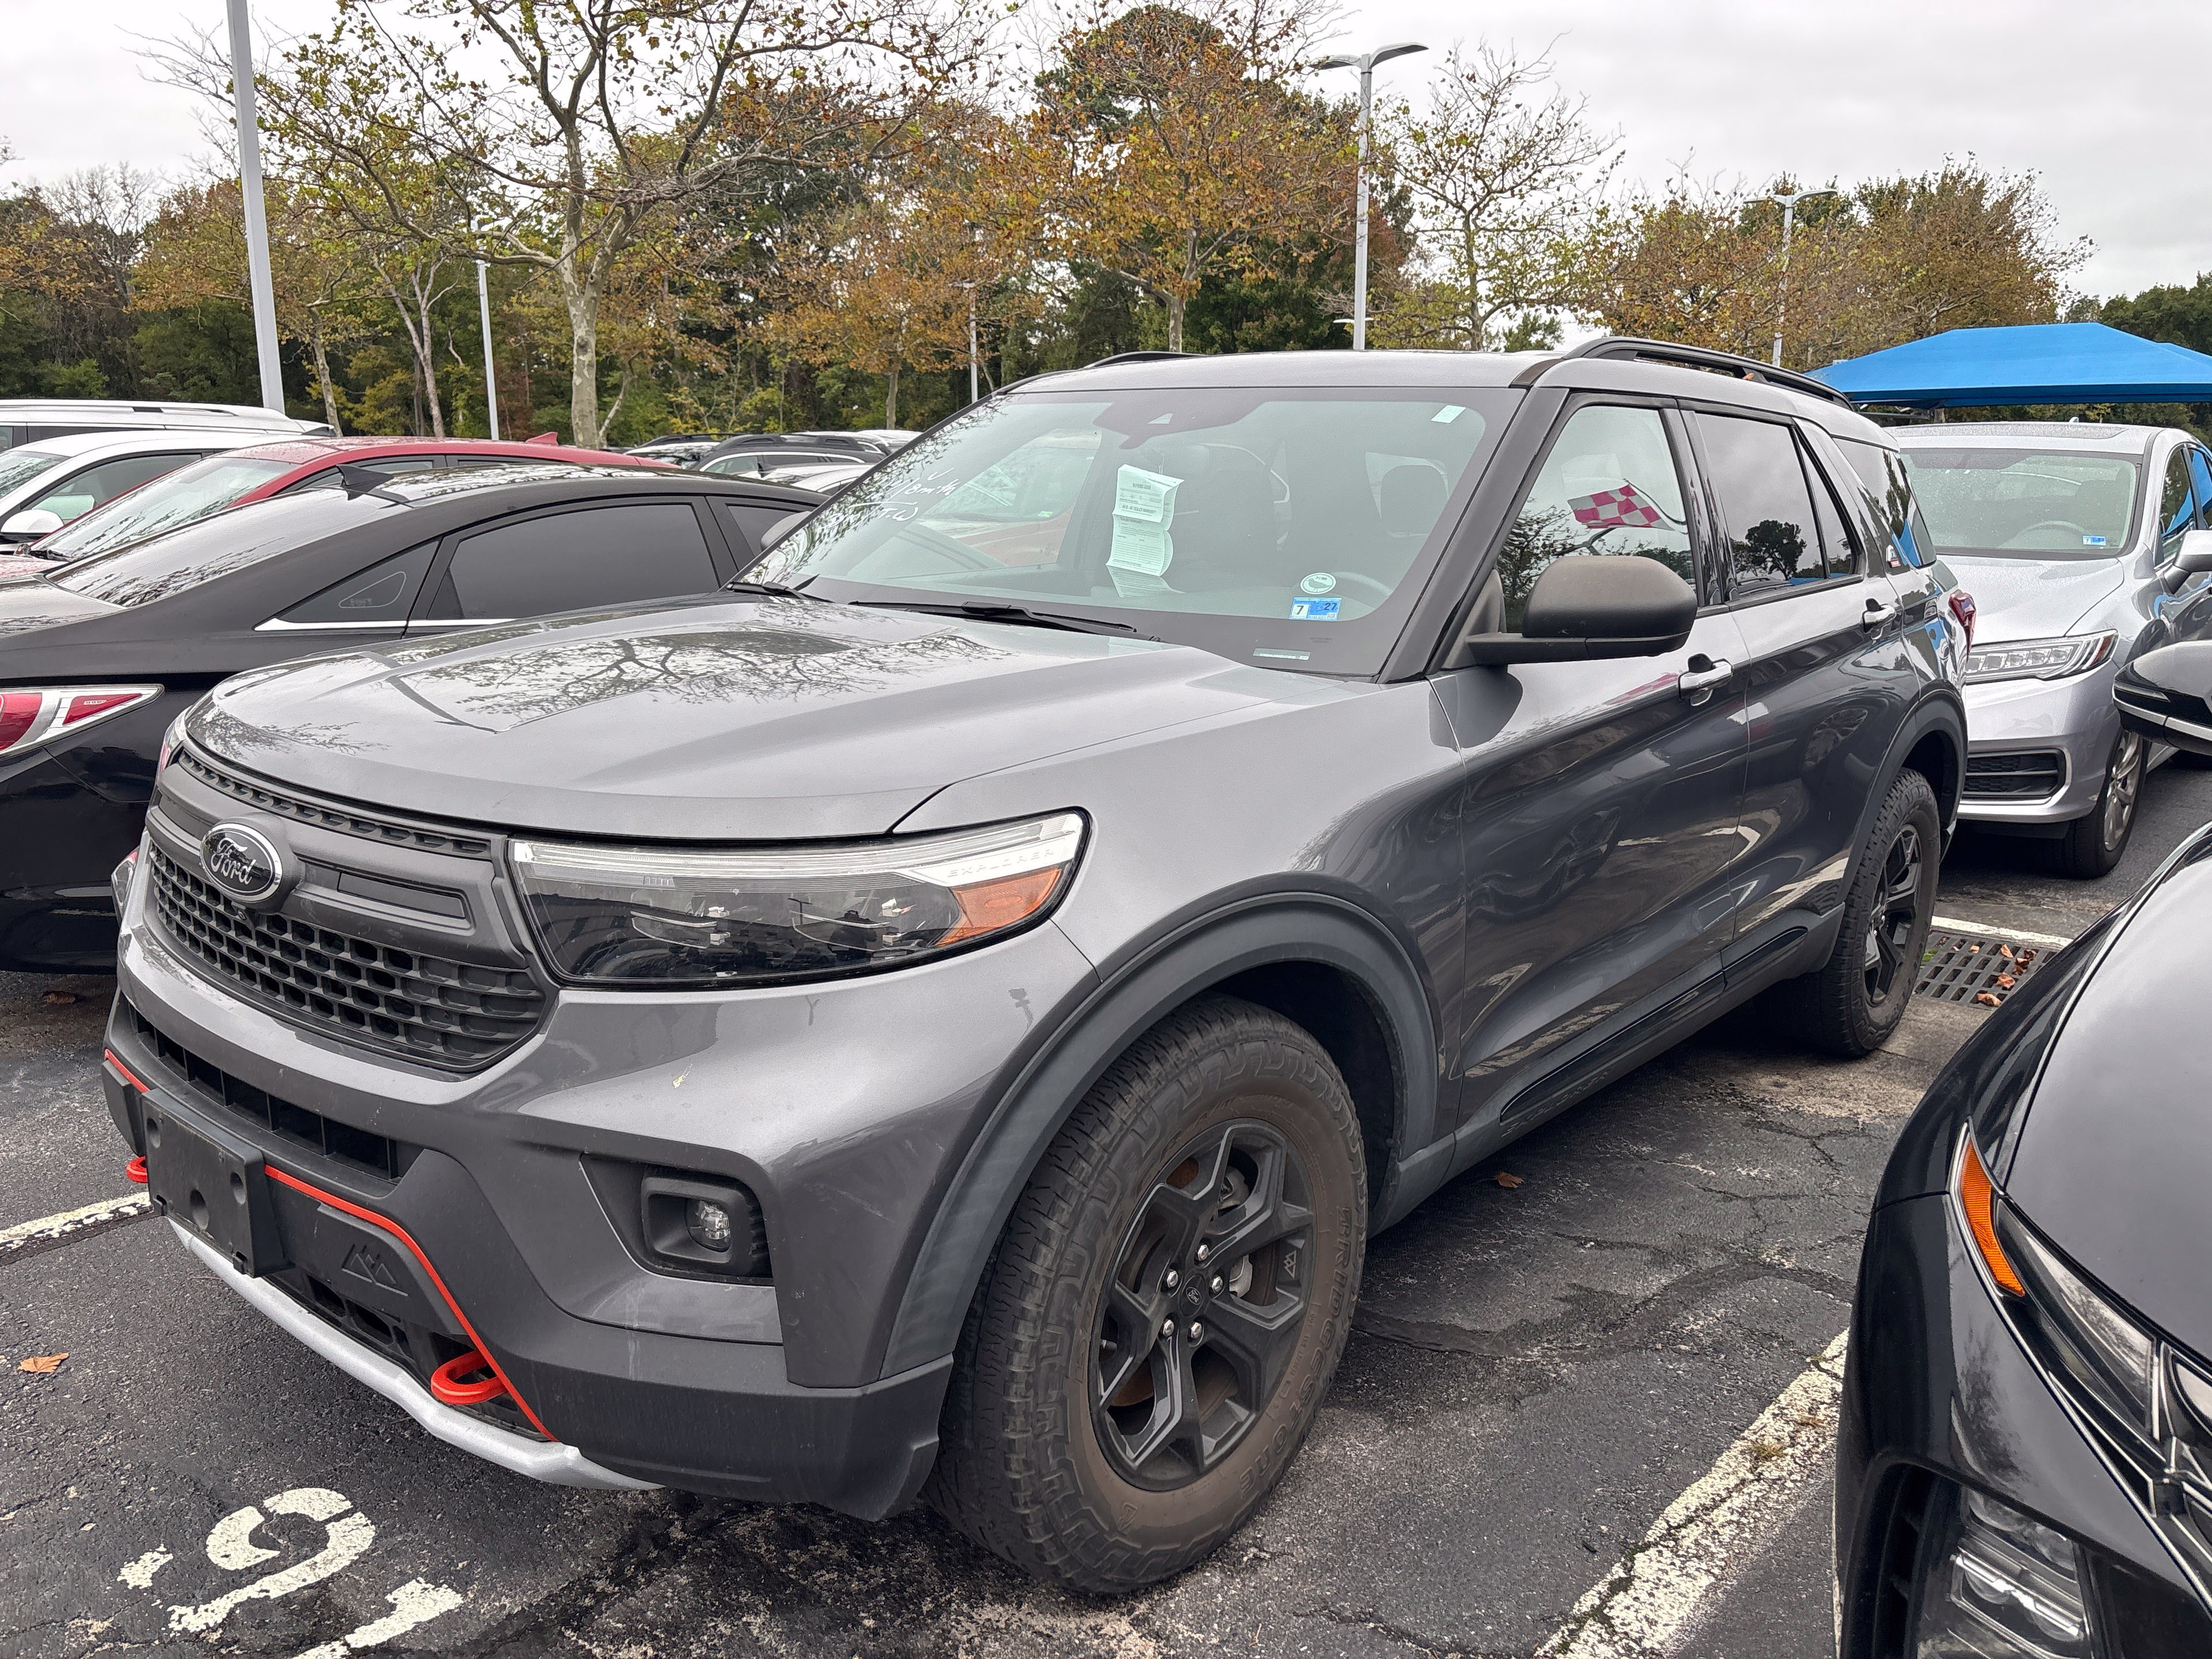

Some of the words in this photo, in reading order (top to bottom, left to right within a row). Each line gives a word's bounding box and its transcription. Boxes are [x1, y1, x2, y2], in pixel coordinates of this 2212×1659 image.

[1297, 605, 1304, 615] 7
[1324, 603, 1337, 611] 27
[210, 837, 257, 885] Ford
[948, 849, 1054, 877] EXPLORER
[1188, 1289, 1200, 1303] Ford
[1240, 1207, 1351, 1499] BRIDGESTONE
